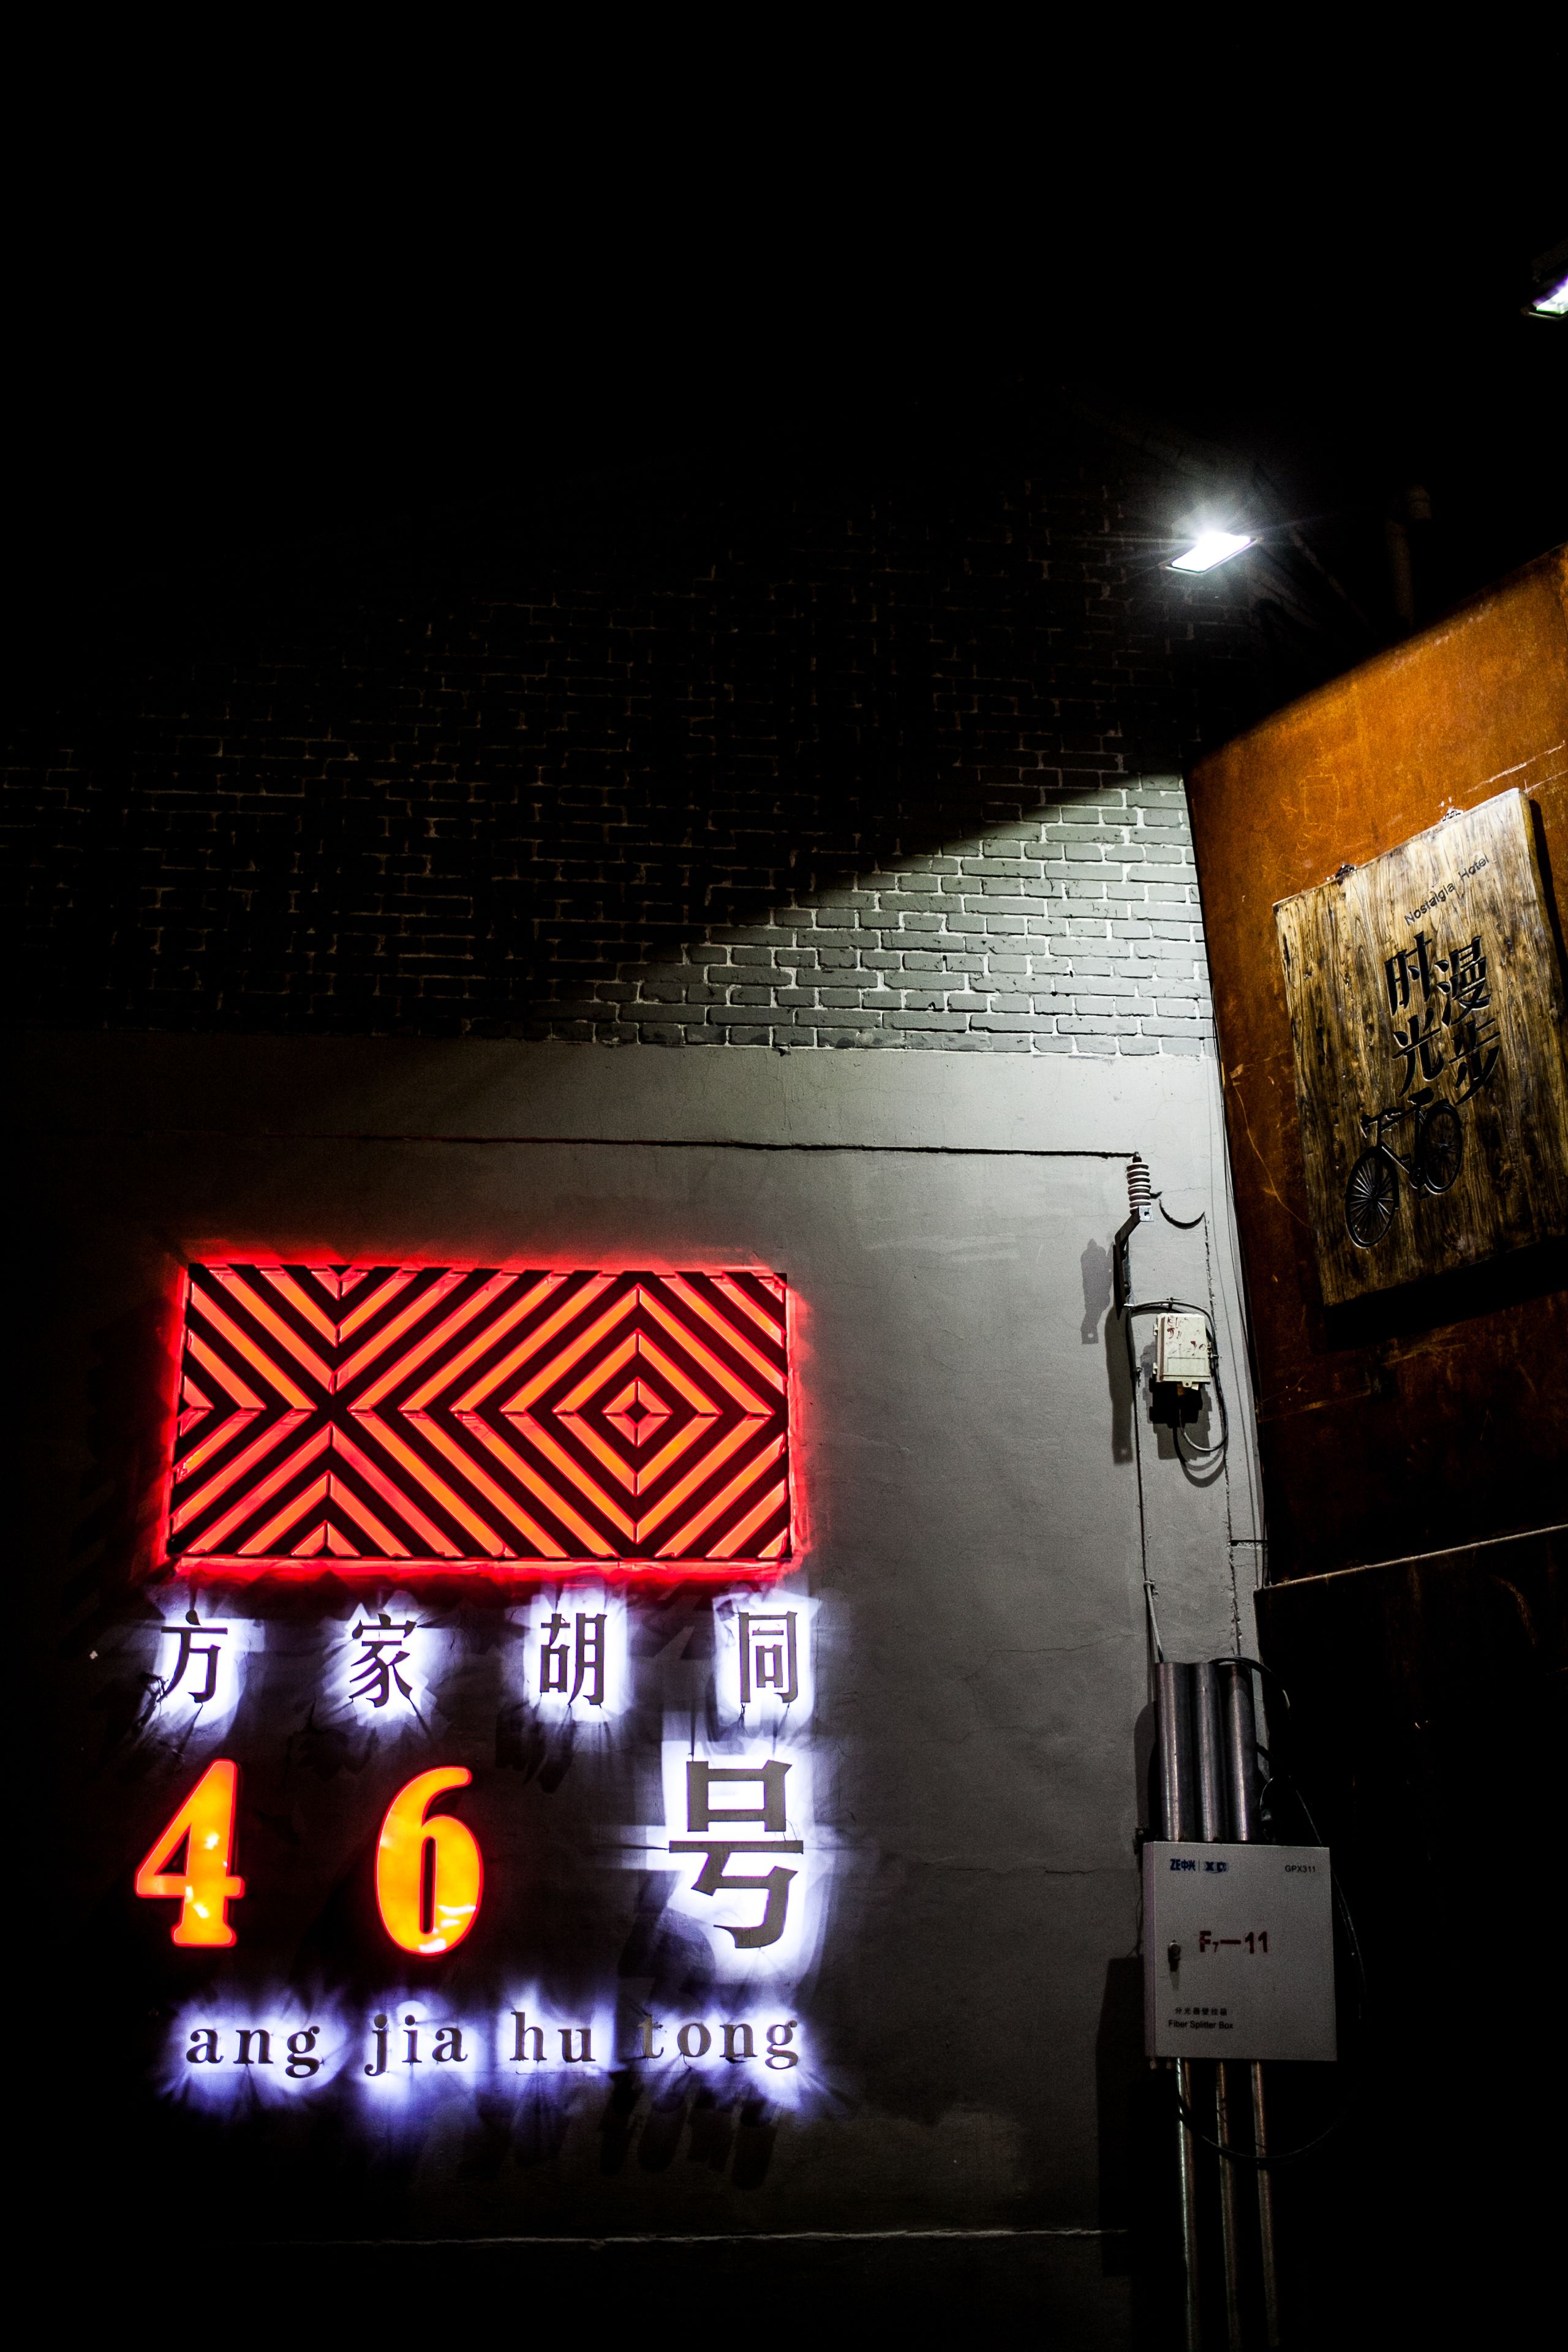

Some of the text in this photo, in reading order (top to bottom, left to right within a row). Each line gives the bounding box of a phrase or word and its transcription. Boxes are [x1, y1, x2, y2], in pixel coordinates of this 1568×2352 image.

[1404, 852, 1490, 926] Nostalgia Hotel
[157, 1609, 799, 1708] 方家胡同
[1284, 1864, 1316, 1873] GPX311
[186, 2011, 799, 2078] ang jia hu tong
[1168, 2019, 1188, 2028] Fiber
[1189, 2020, 1216, 2030] Splitter
